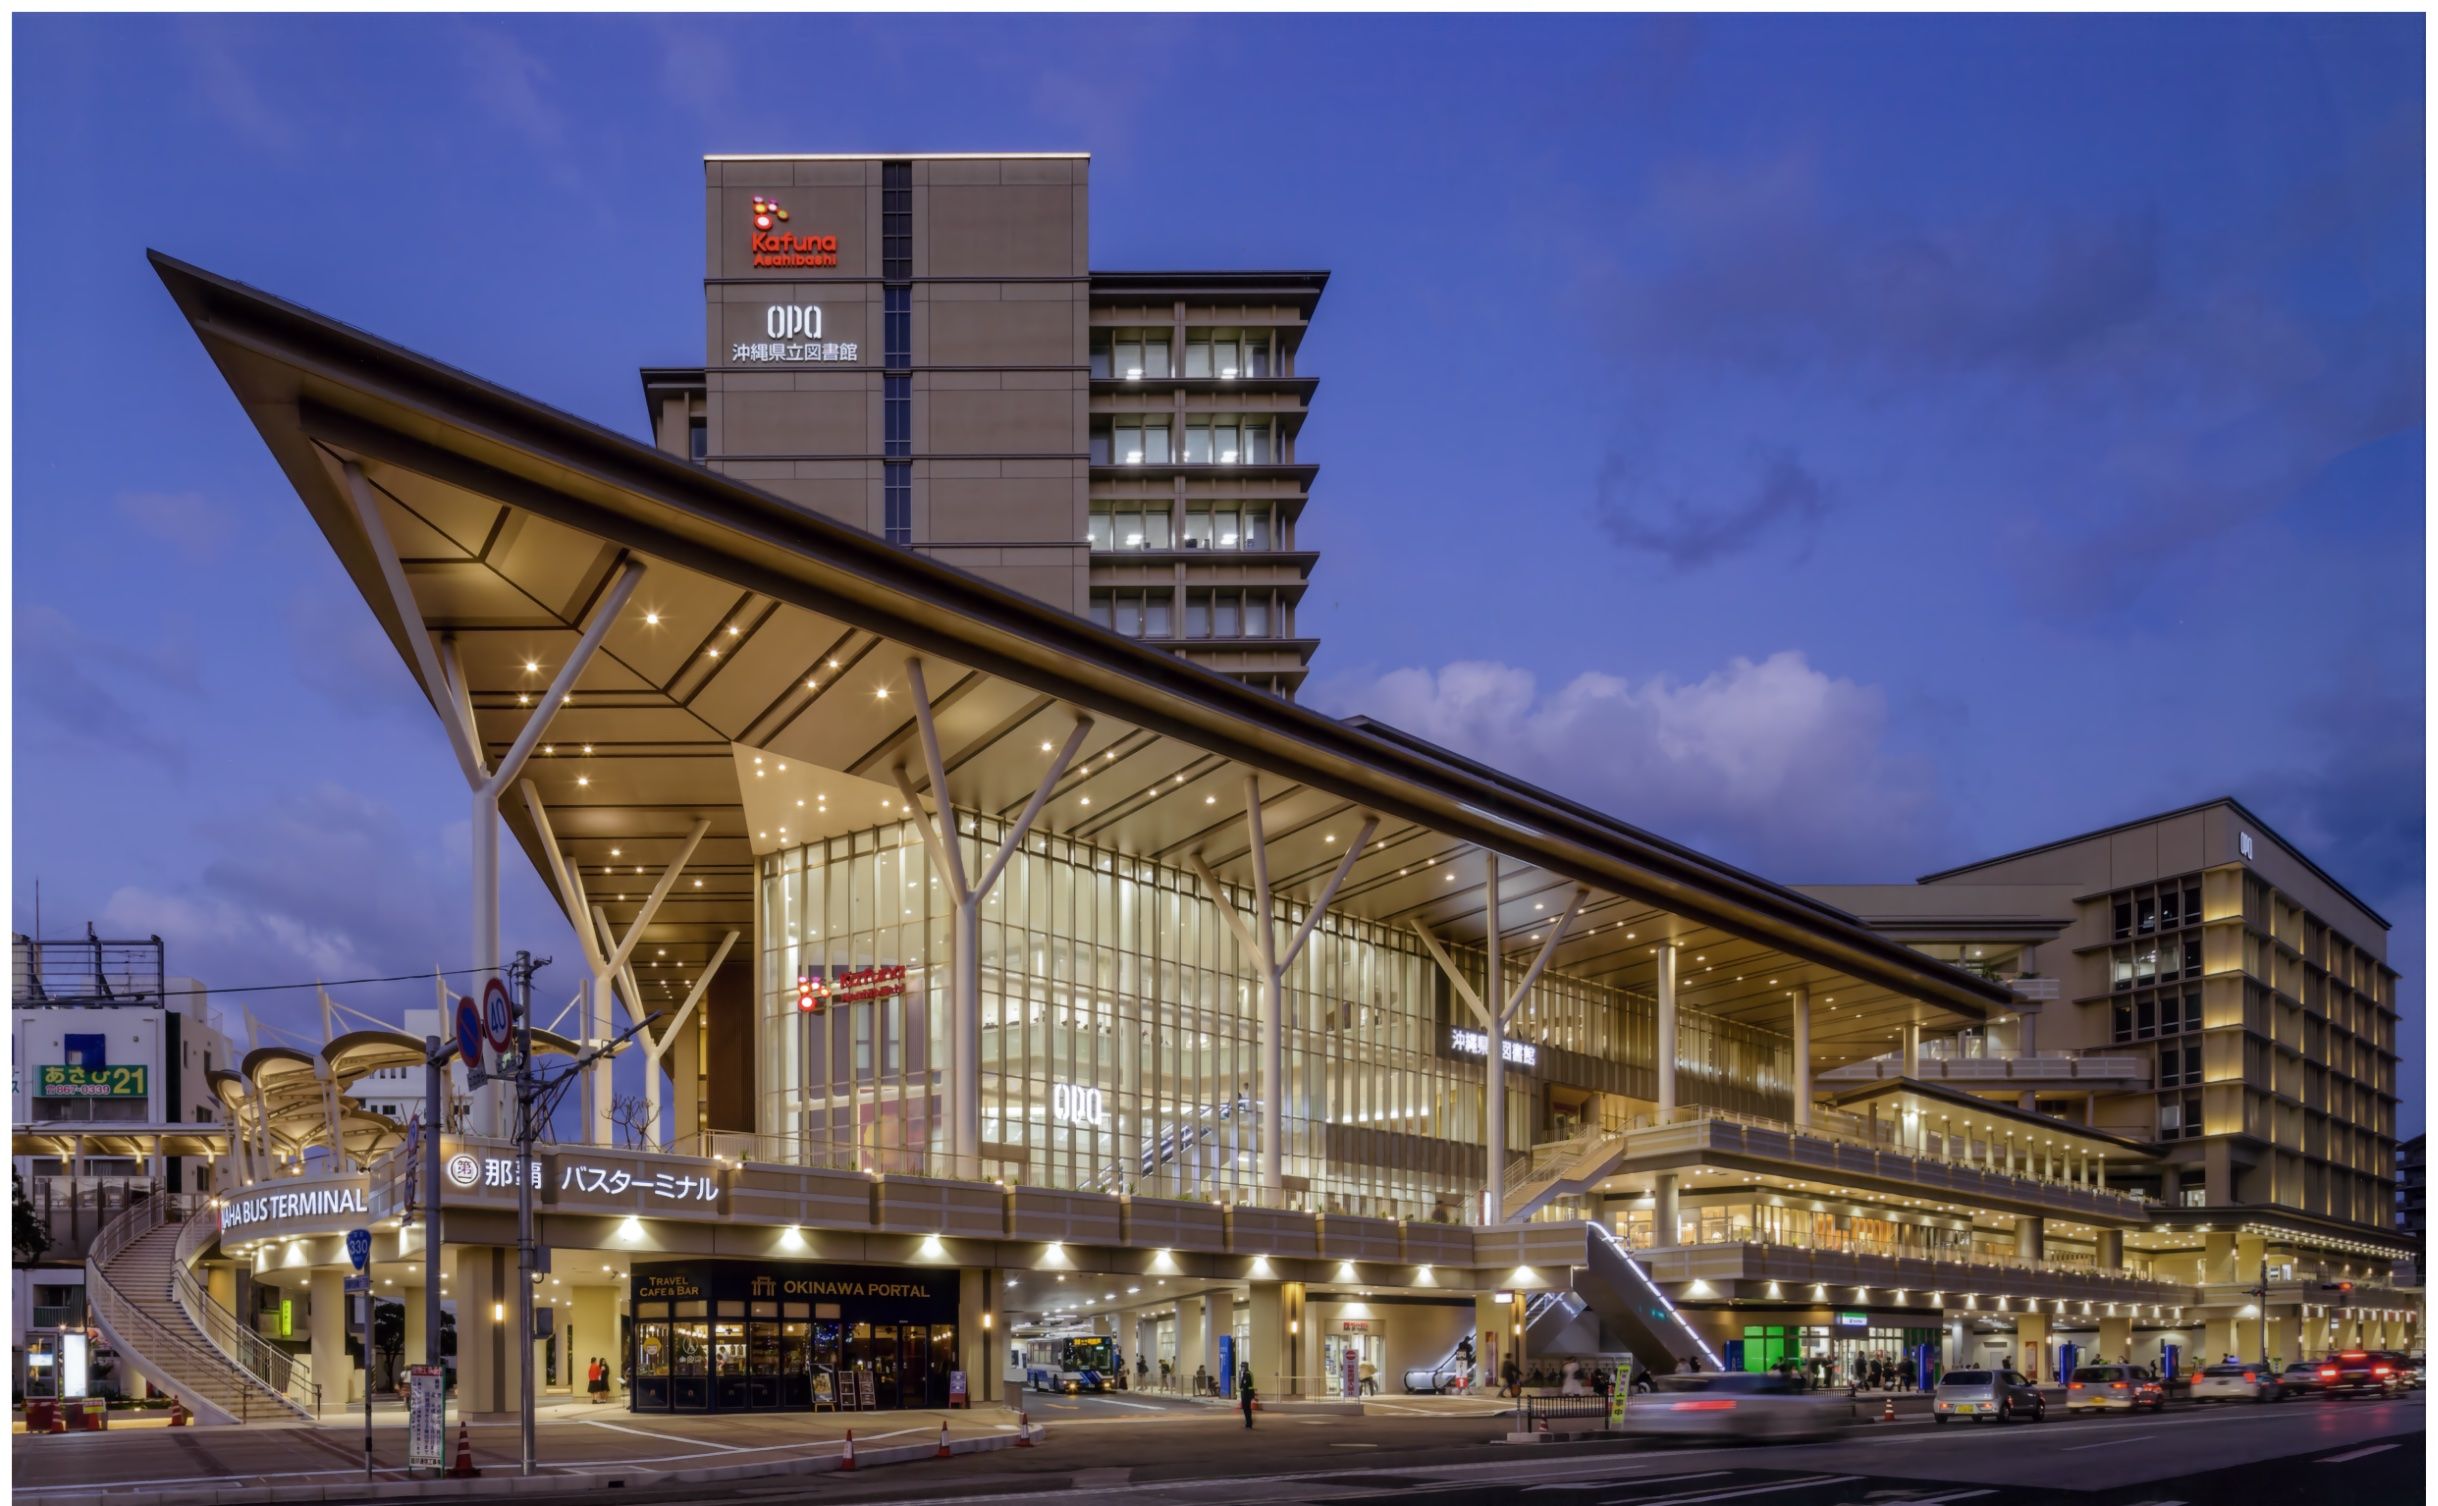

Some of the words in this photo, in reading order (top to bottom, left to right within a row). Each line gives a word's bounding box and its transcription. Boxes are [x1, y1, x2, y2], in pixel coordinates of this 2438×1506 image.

[752, 232, 837, 251] Kafuna
[754, 254, 837, 266] Asahibashi
[732, 343, 858, 362] 沖縄県立図書館
[491, 998, 506, 1033] 40
[1451, 1029, 1536, 1066] 沖縄県図書館
[561, 1166, 719, 1201] バスターミナル
[243, 1196, 269, 1224] BUS
[269, 1188, 368, 1219] TERMINAL
[350, 1239, 368, 1254] 330
[649, 1276, 689, 1286] TRAVEL
[783, 1280, 865, 1296] OKINAWA
[868, 1283, 931, 1298] PORTAL
[639, 1287, 667, 1297] CAFE
[677, 1286, 699, 1296] BAR
